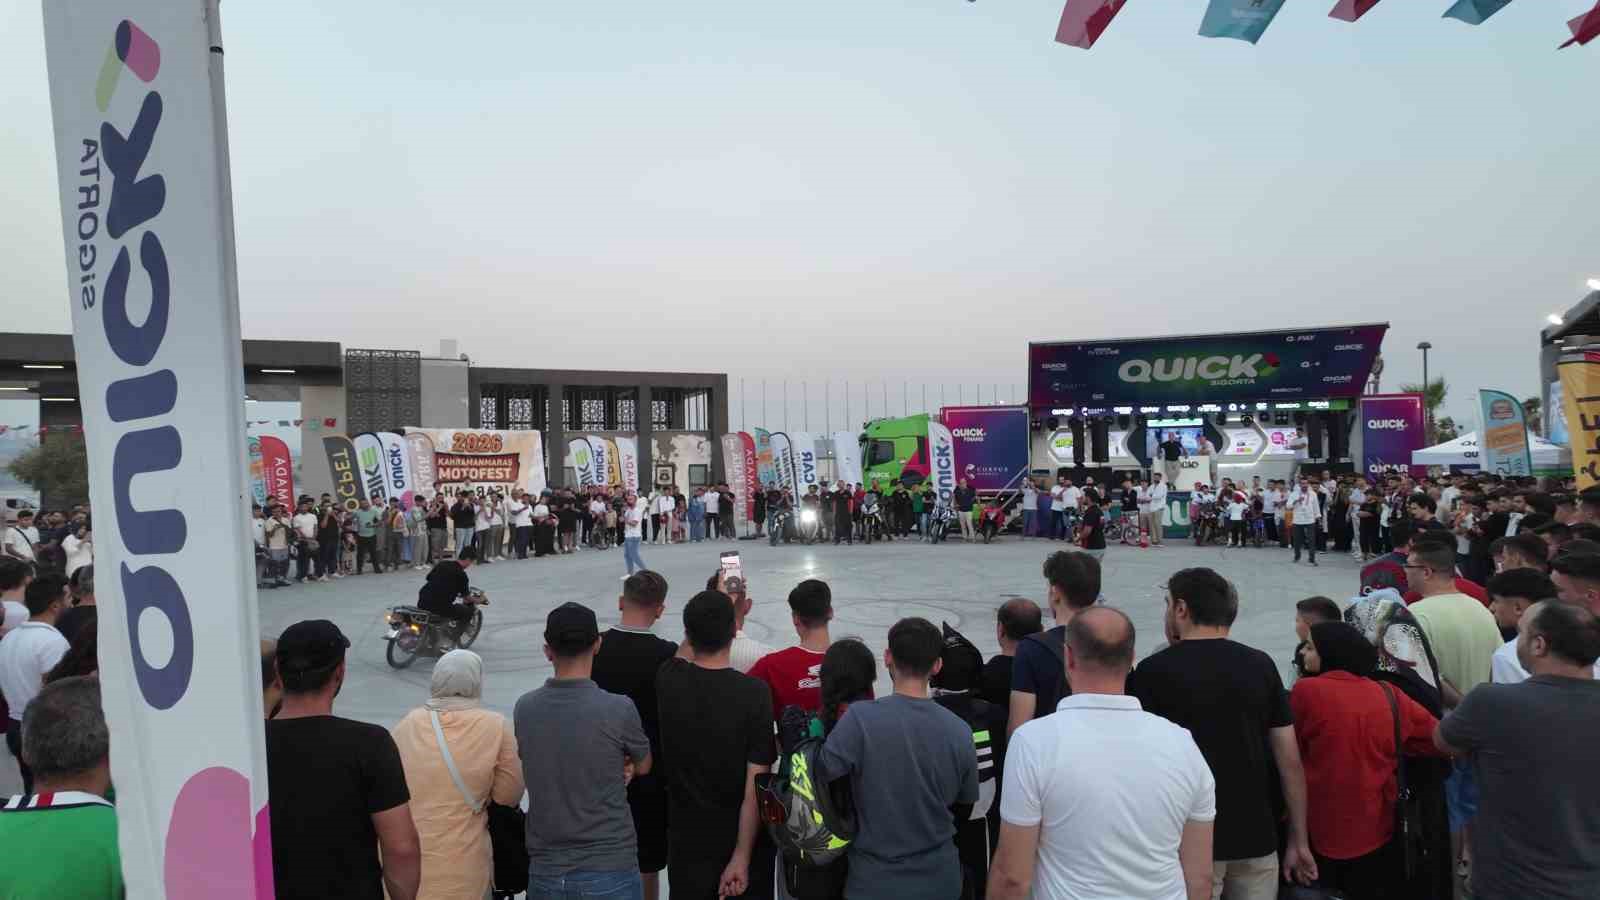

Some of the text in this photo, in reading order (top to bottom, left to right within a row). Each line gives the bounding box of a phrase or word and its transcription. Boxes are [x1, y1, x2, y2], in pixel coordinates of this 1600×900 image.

[1117, 353, 1263, 383] QUICK
[1368, 419, 1404, 429] QUICK
[952, 427, 984, 437] QUICK
[452, 432, 503, 452] 2026
[438, 467, 512, 480] MOTOFEST
